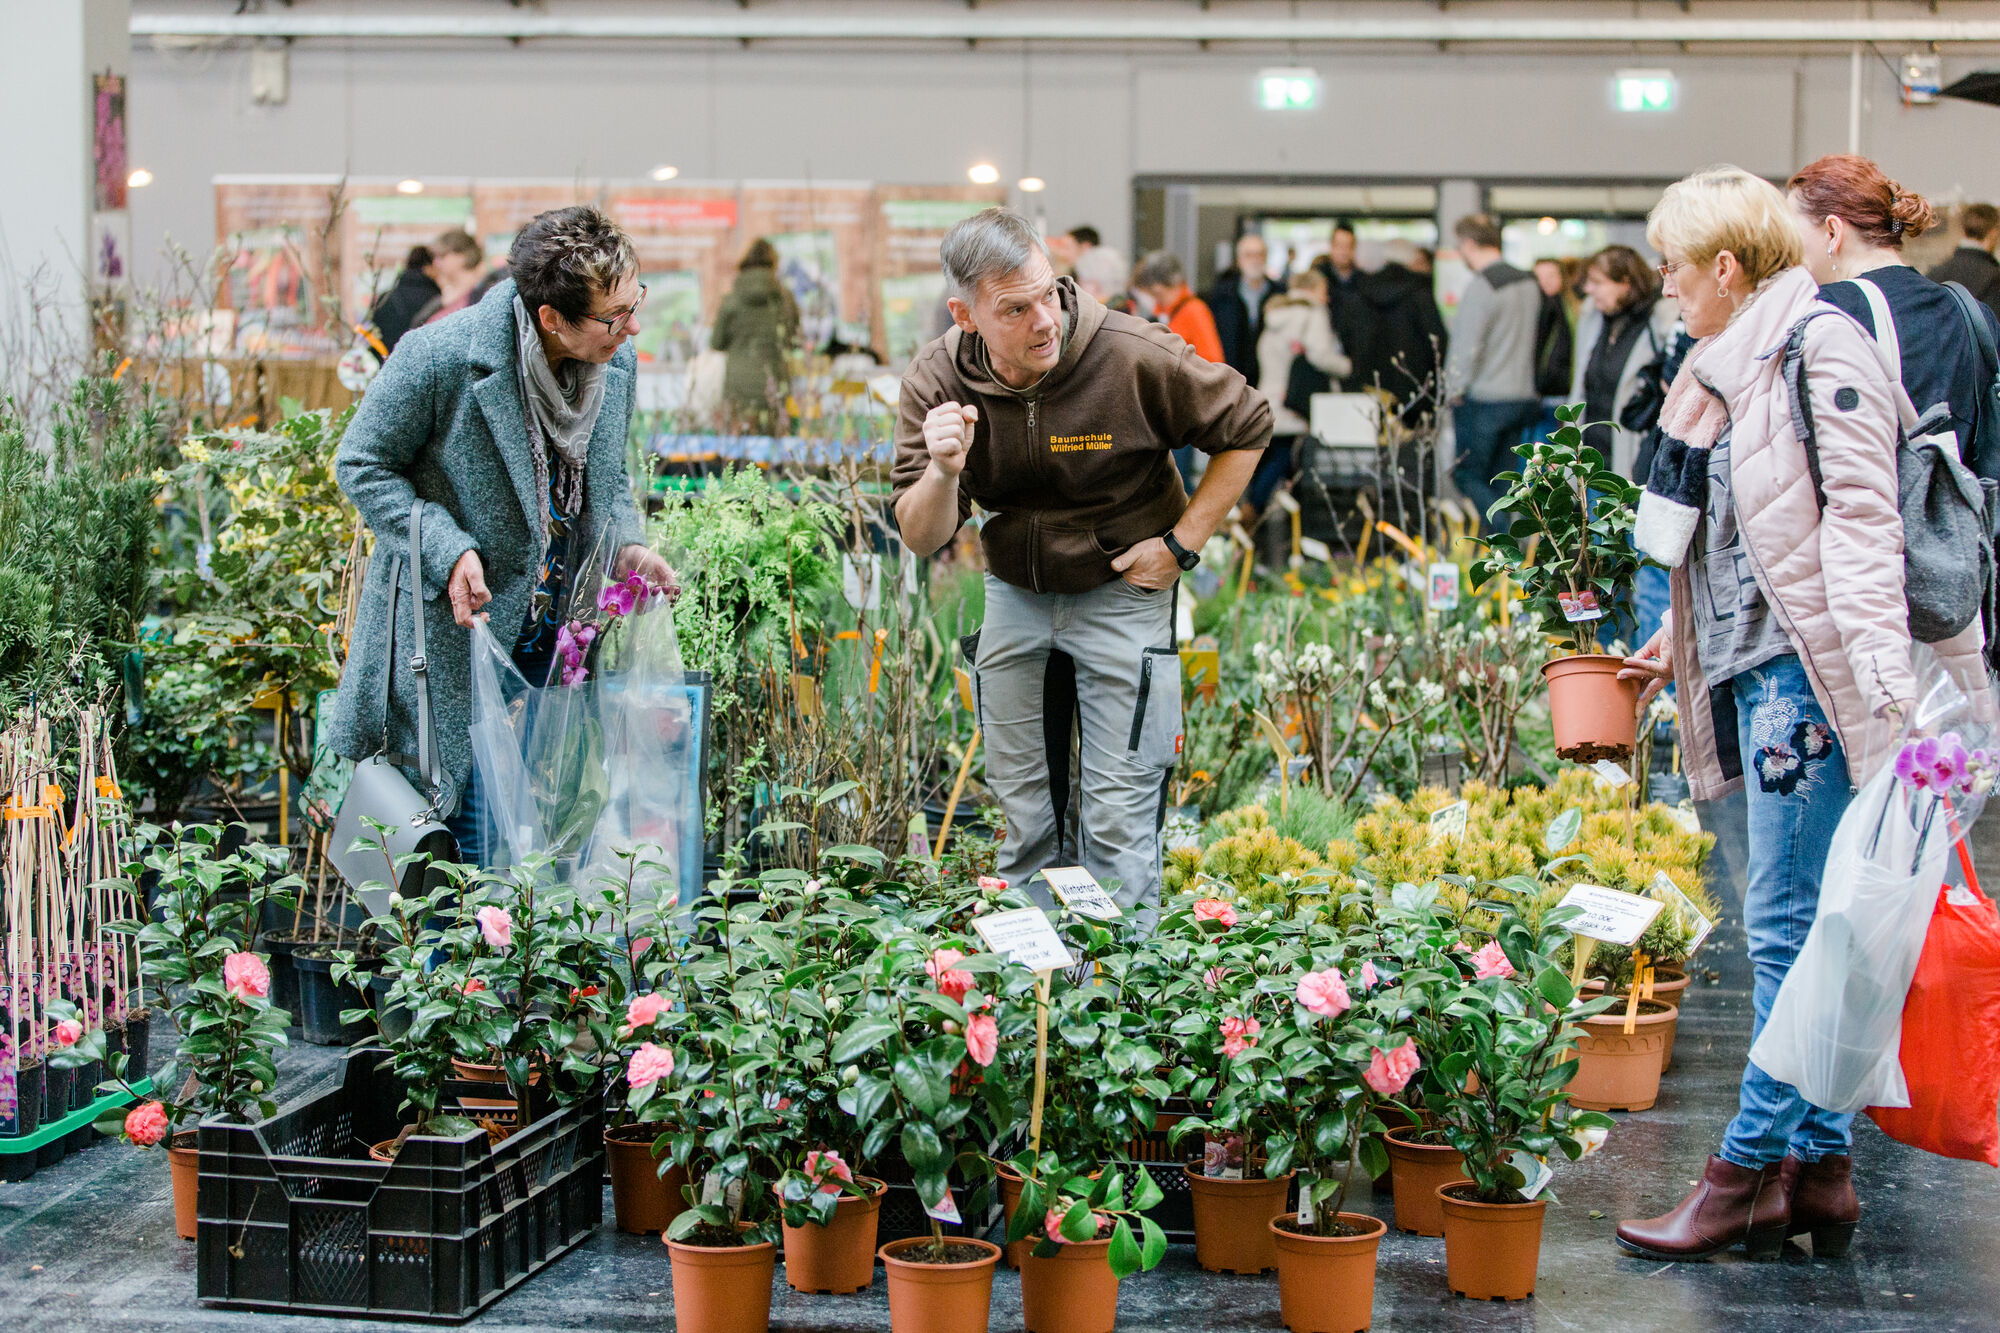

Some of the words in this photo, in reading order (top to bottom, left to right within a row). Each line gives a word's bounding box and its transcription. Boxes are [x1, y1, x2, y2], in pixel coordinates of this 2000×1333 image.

[1050, 433, 1112, 443] Baumschule
[1050, 443, 1084, 453] Wilfried
[1086, 442, 1113, 450] Müller
